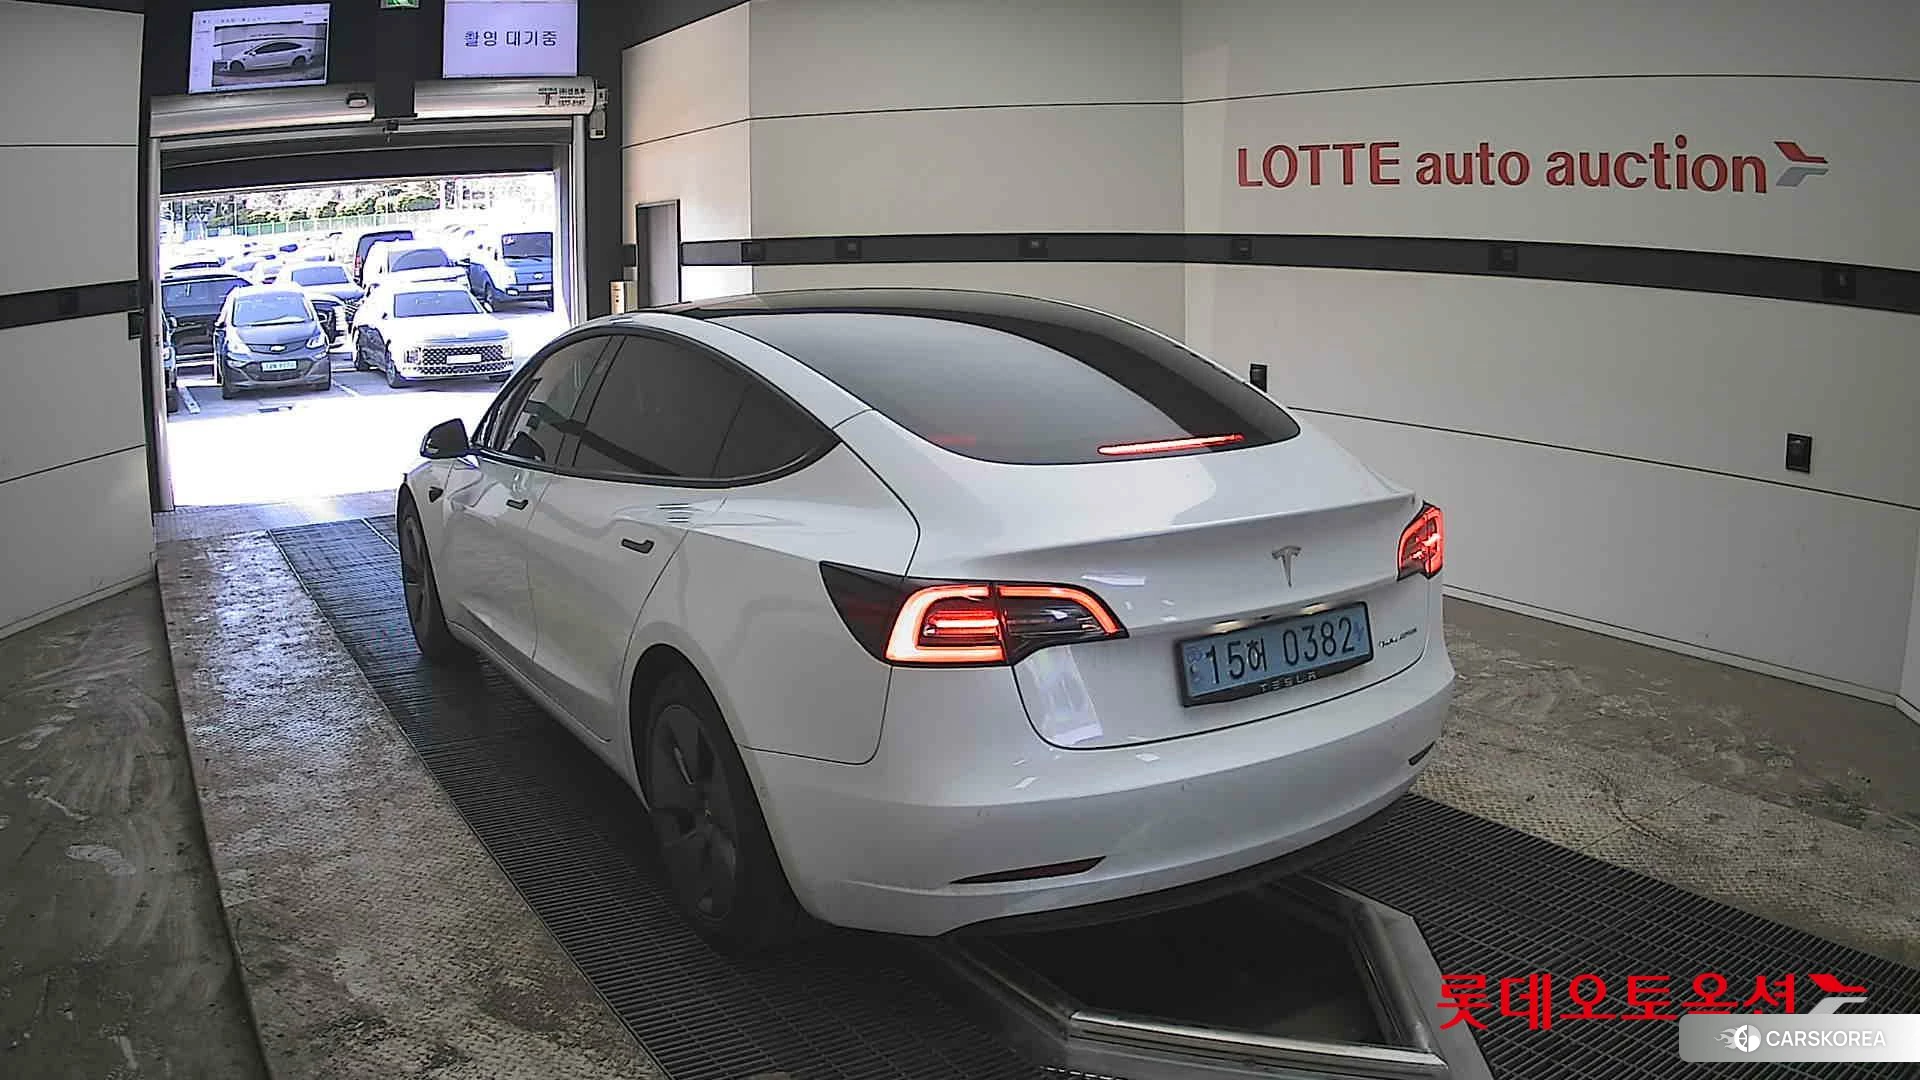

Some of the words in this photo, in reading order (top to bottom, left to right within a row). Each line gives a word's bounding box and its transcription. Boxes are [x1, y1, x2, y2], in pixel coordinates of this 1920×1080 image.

[505, 30, 558, 48] 대기중
[1236, 142, 1400, 188] LOTTE
[1416, 143, 1530, 185] auto
[1546, 135, 1767, 193] auction
[1205, 637, 1268, 685] 15허
[1282, 616, 1356, 666] 0382
[1259, 671, 1321, 693] TESLA
